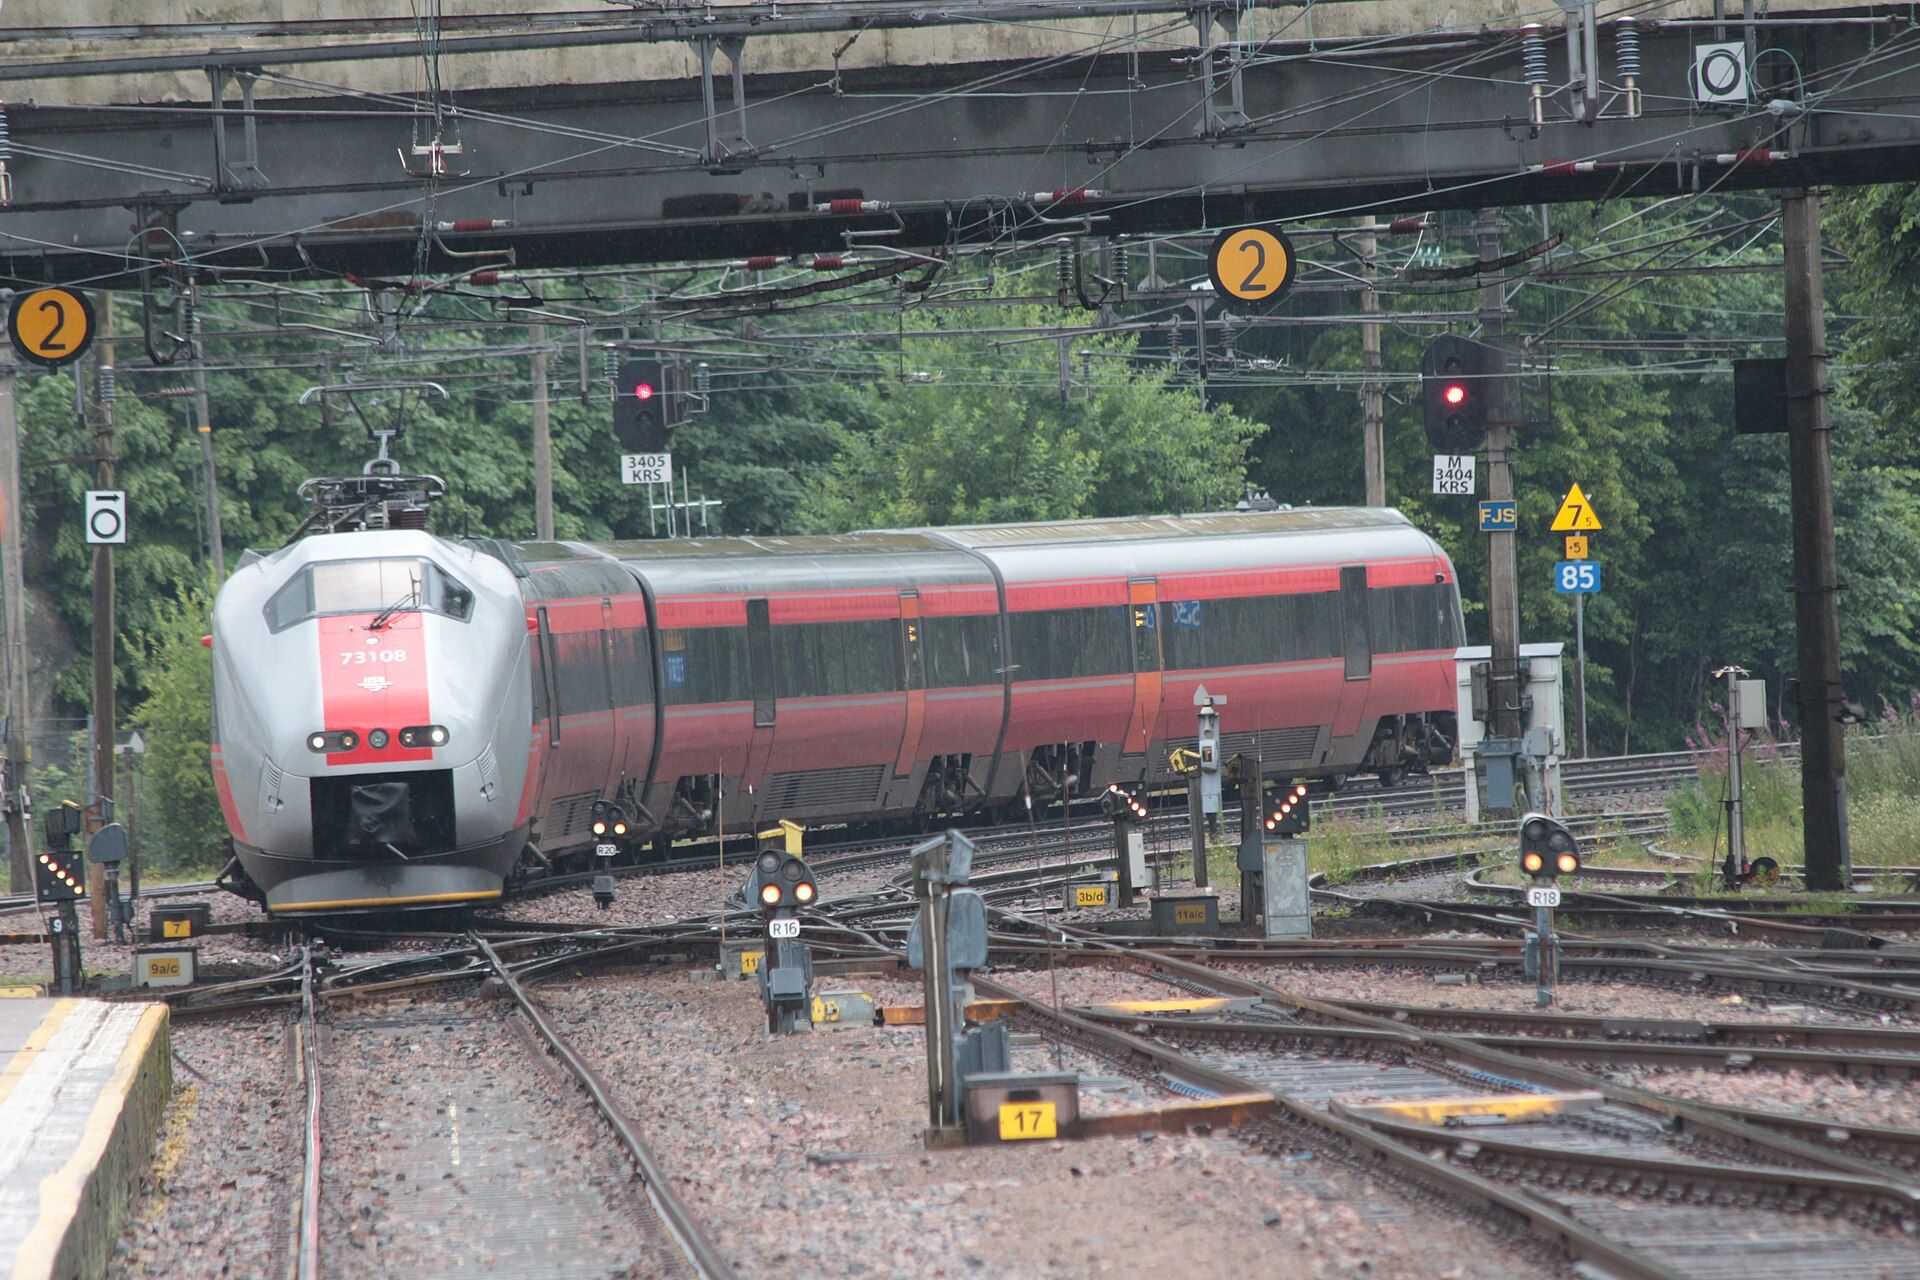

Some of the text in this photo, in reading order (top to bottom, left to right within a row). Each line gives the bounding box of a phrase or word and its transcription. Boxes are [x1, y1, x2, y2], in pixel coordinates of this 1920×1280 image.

[1239, 239, 1267, 292] 2
[39, 300, 66, 351] 2
[628, 456, 666, 469] 3405
[1448, 456, 1462, 469] M
[632, 469, 662, 482] KRS
[1435, 469, 1474, 481] 3404
[1439, 481, 1469, 493] KRS
[1481, 508, 1516, 523] FJS
[1562, 565, 1595, 589] 85
[340, 649, 407, 665] 73108
[1079, 891, 1104, 902] 3b/d
[1533, 891, 1557, 904] R18
[53, 918, 63, 933] 9
[173, 923, 181, 935] 7
[150, 963, 178, 975] 9a/c
[744, 957, 760, 968] 11
[1014, 1110, 1043, 1133] 17
